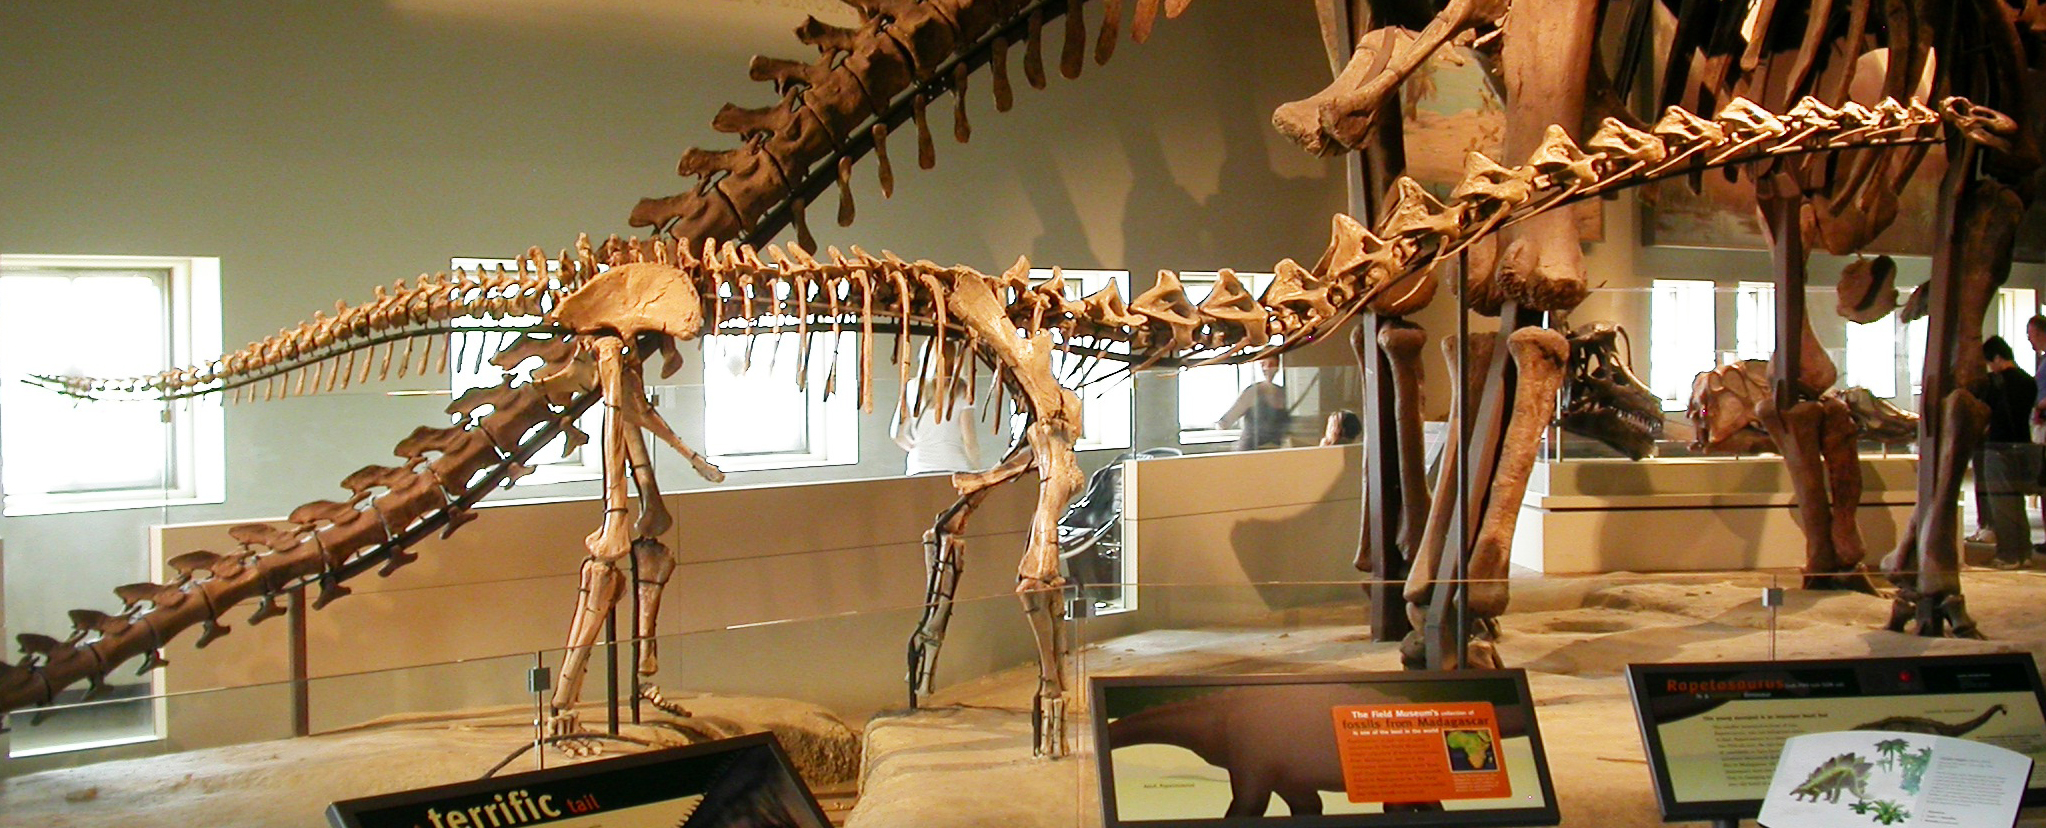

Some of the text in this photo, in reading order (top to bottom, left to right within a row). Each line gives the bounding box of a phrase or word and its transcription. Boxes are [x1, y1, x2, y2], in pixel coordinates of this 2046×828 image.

[1351, 710, 1369, 719] The
[1371, 710, 1393, 718] Field
[1395, 709, 1440, 718] Museum's
[1342, 717, 1489, 729] fossils from Madagascar
[427, 789, 600, 828] terrific tail
